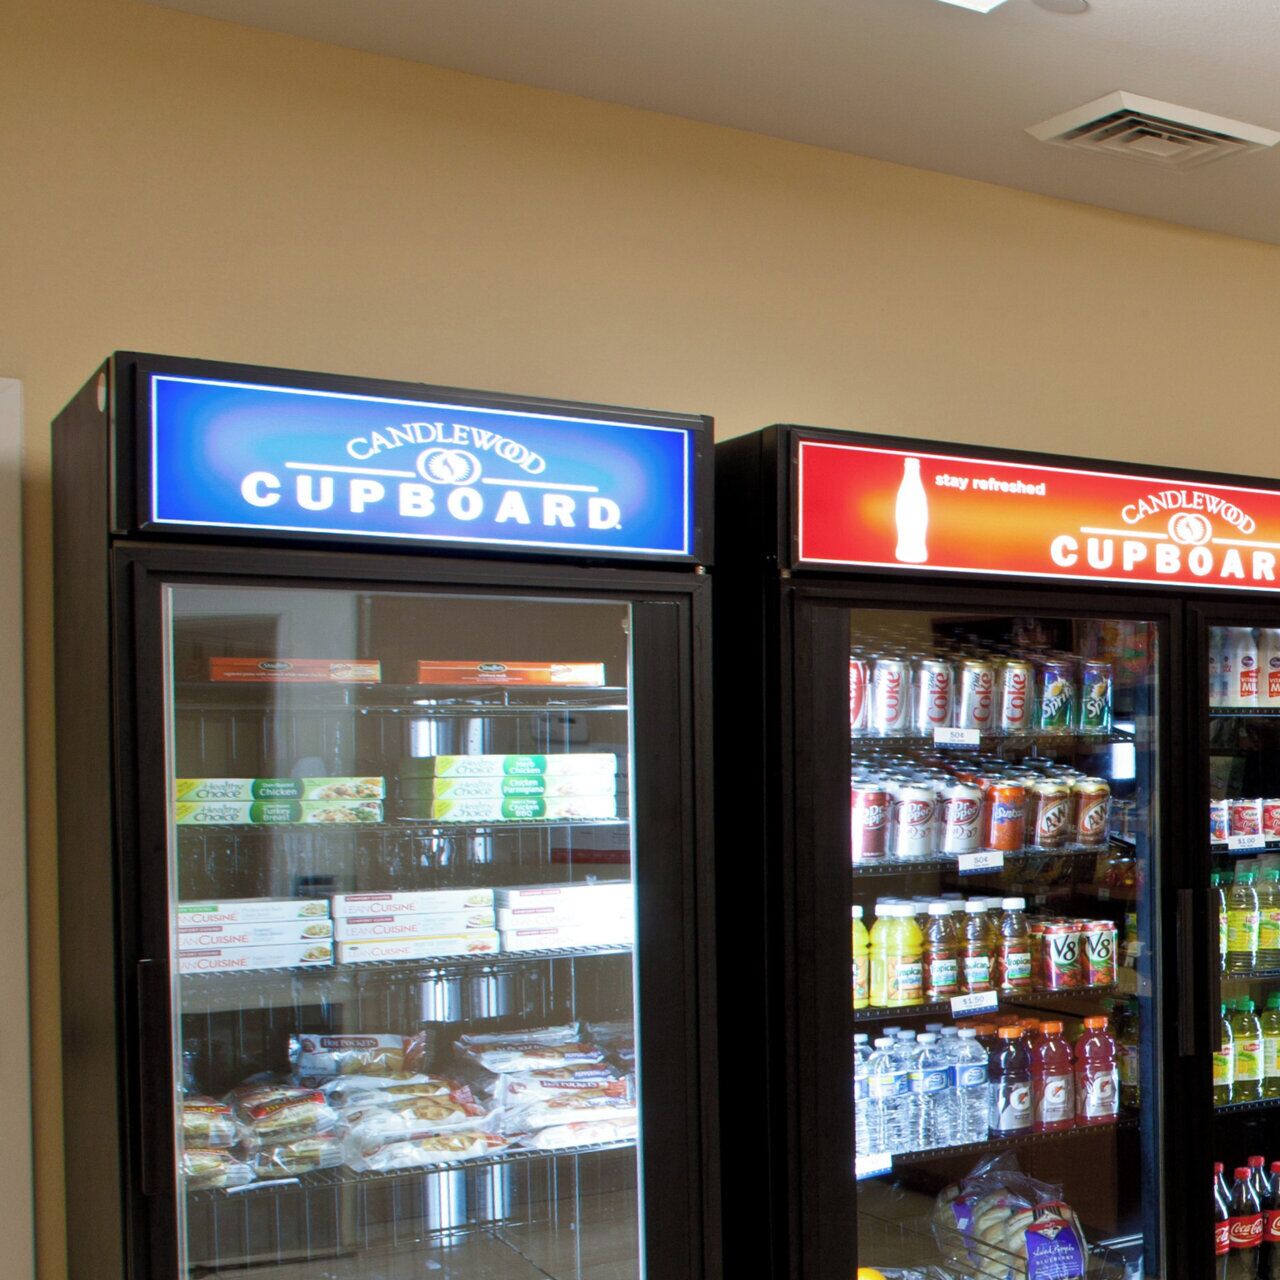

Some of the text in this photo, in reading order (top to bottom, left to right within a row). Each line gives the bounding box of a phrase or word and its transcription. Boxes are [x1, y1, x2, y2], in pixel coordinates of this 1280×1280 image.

[346, 422, 546, 475] CANDLEWOOD
[241, 471, 622, 530] CUPBOARD
[934, 472, 1046, 497] stay refreshed
[1121, 490, 1256, 535] CANDLEWOOD
[928, 672, 950, 723] Coke
[973, 672, 993, 723] Coke
[1005, 672, 1027, 723] Coke
[1054, 938, 1076, 961] V8
[1087, 935, 1111, 959] V8
